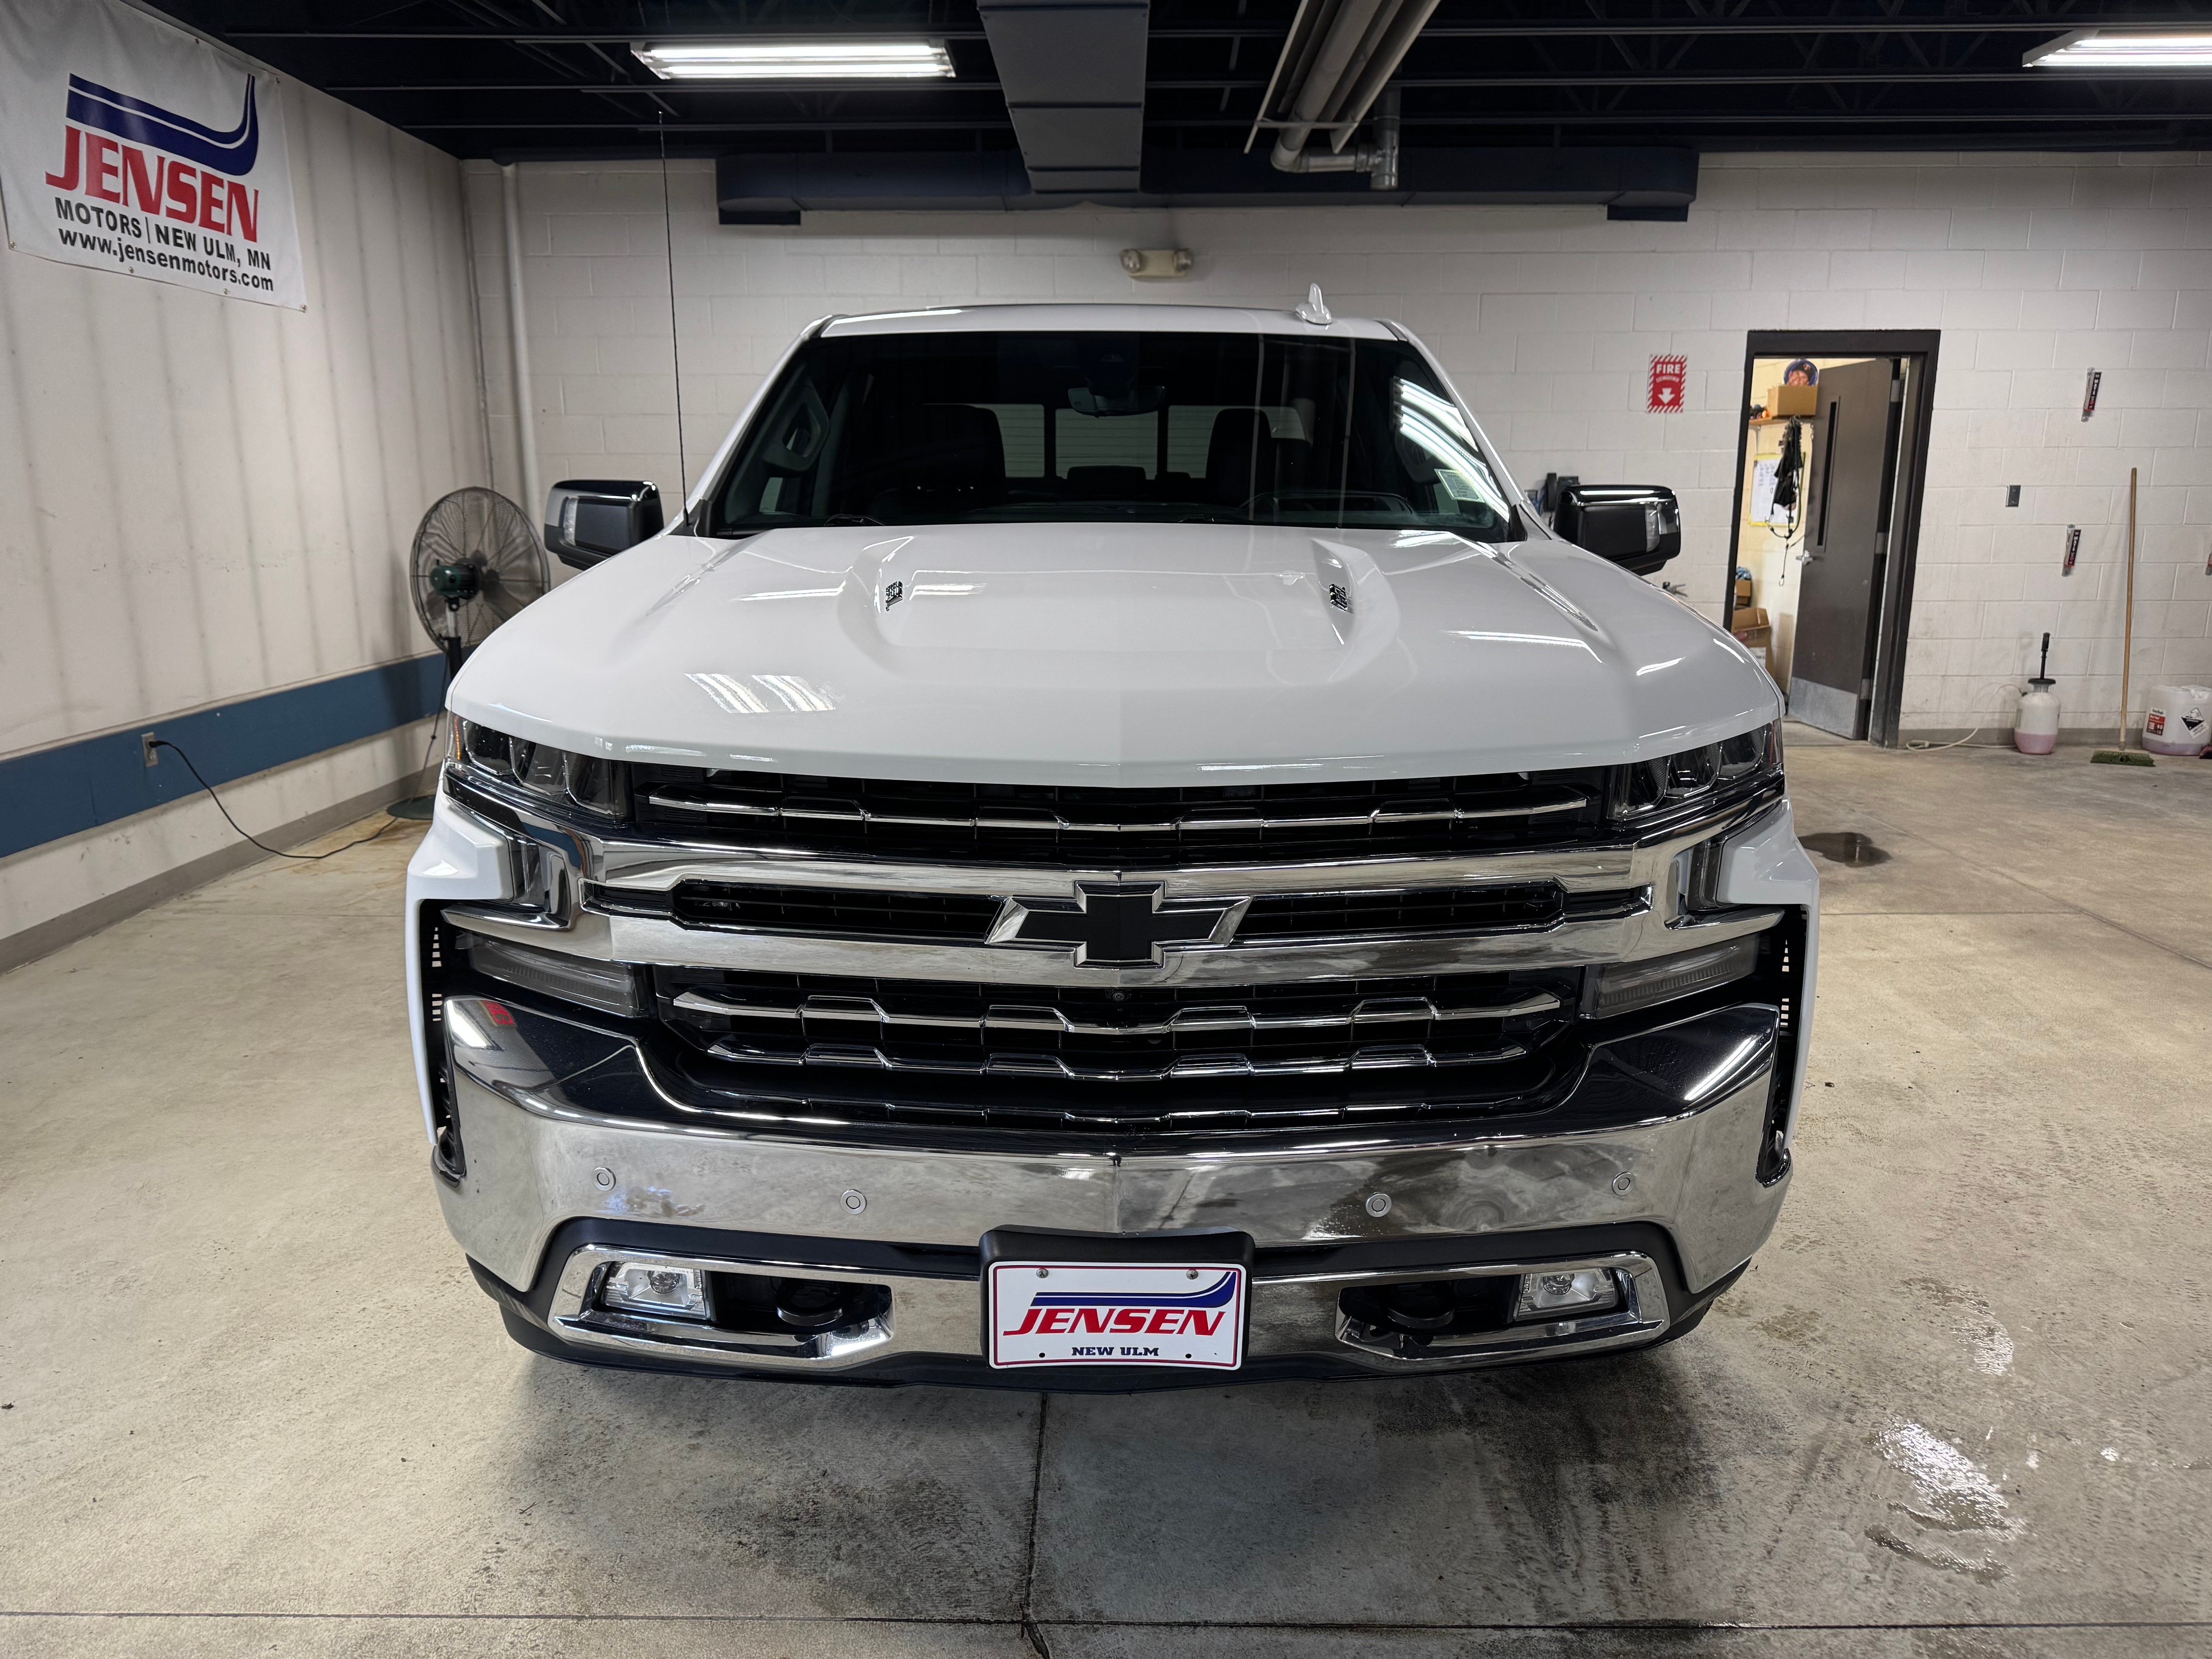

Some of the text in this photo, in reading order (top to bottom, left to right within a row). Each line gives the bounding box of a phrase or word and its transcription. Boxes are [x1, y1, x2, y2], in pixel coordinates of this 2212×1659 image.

[46, 125, 259, 243] JENSEN
[55, 197, 271, 270] MOTORS NEW ULM, MN
[58, 228, 273, 291] www.jensenmotors.com
[1656, 364, 1681, 374] FIRE
[1003, 1308, 1225, 1336] JENSEN
[1072, 1347, 1159, 1356] NEW ULM
